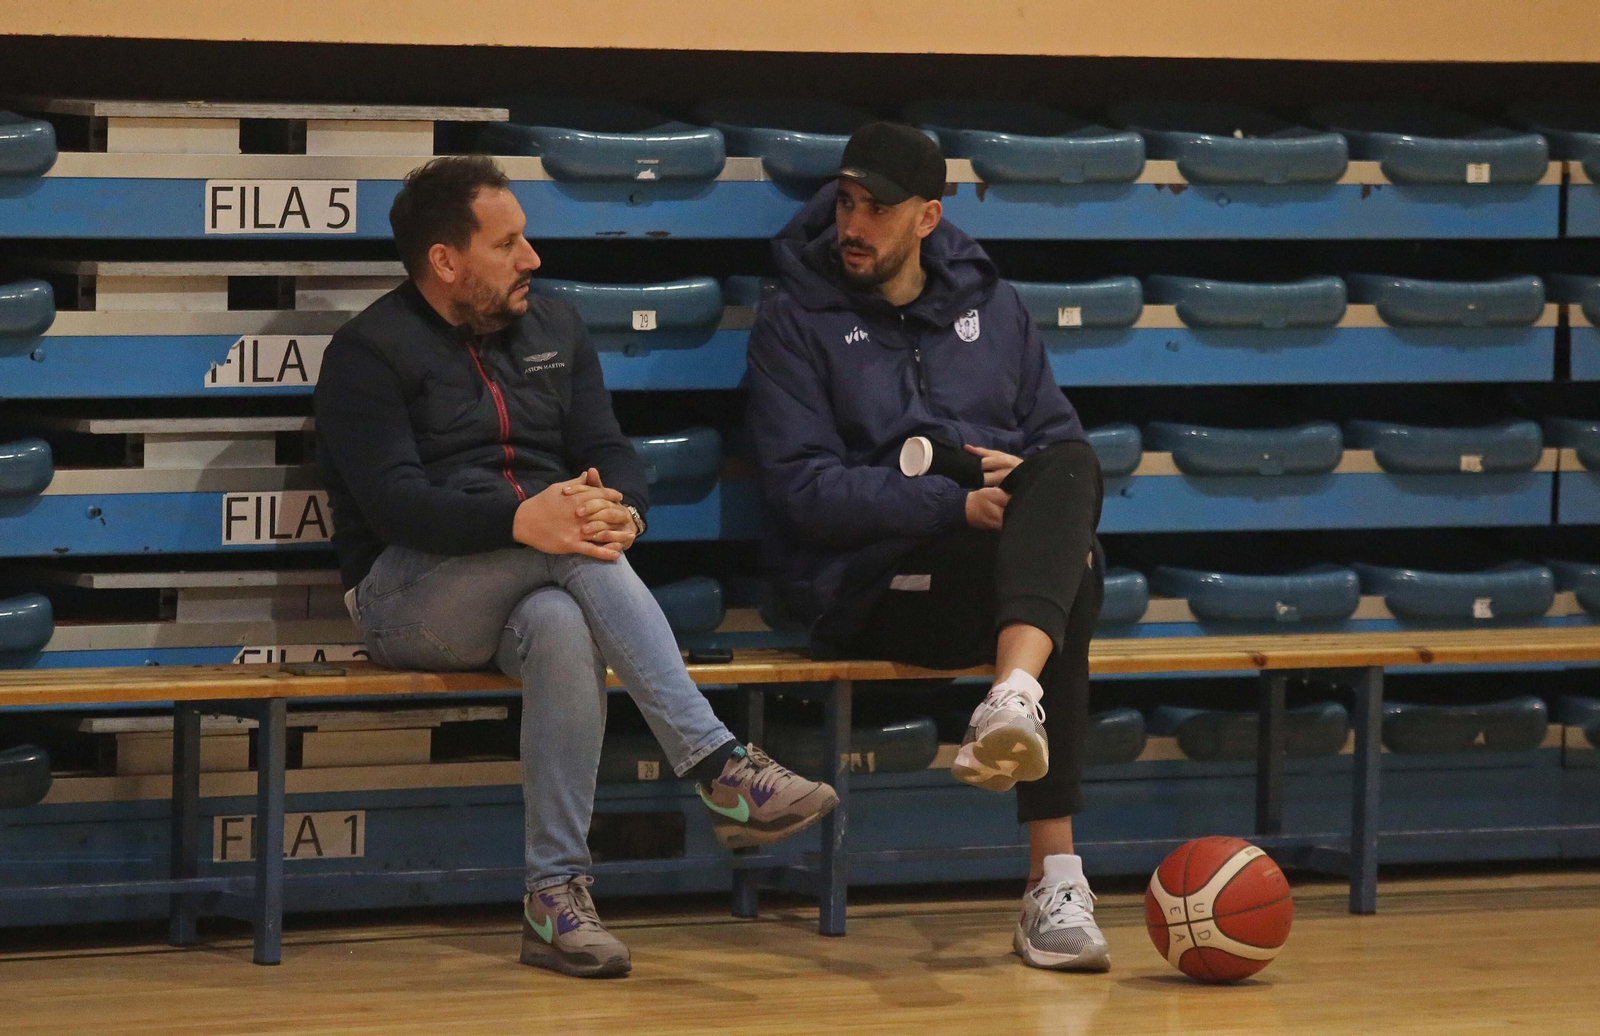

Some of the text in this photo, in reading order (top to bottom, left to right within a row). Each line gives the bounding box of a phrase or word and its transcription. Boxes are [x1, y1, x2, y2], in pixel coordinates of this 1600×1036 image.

[211, 186, 350, 230] FILA 5
[639, 313, 649, 328] 29
[524, 362, 565, 374] ASTON MARTIN
[225, 495, 328, 541] FILA
[221, 814, 358, 860] FIA 1
